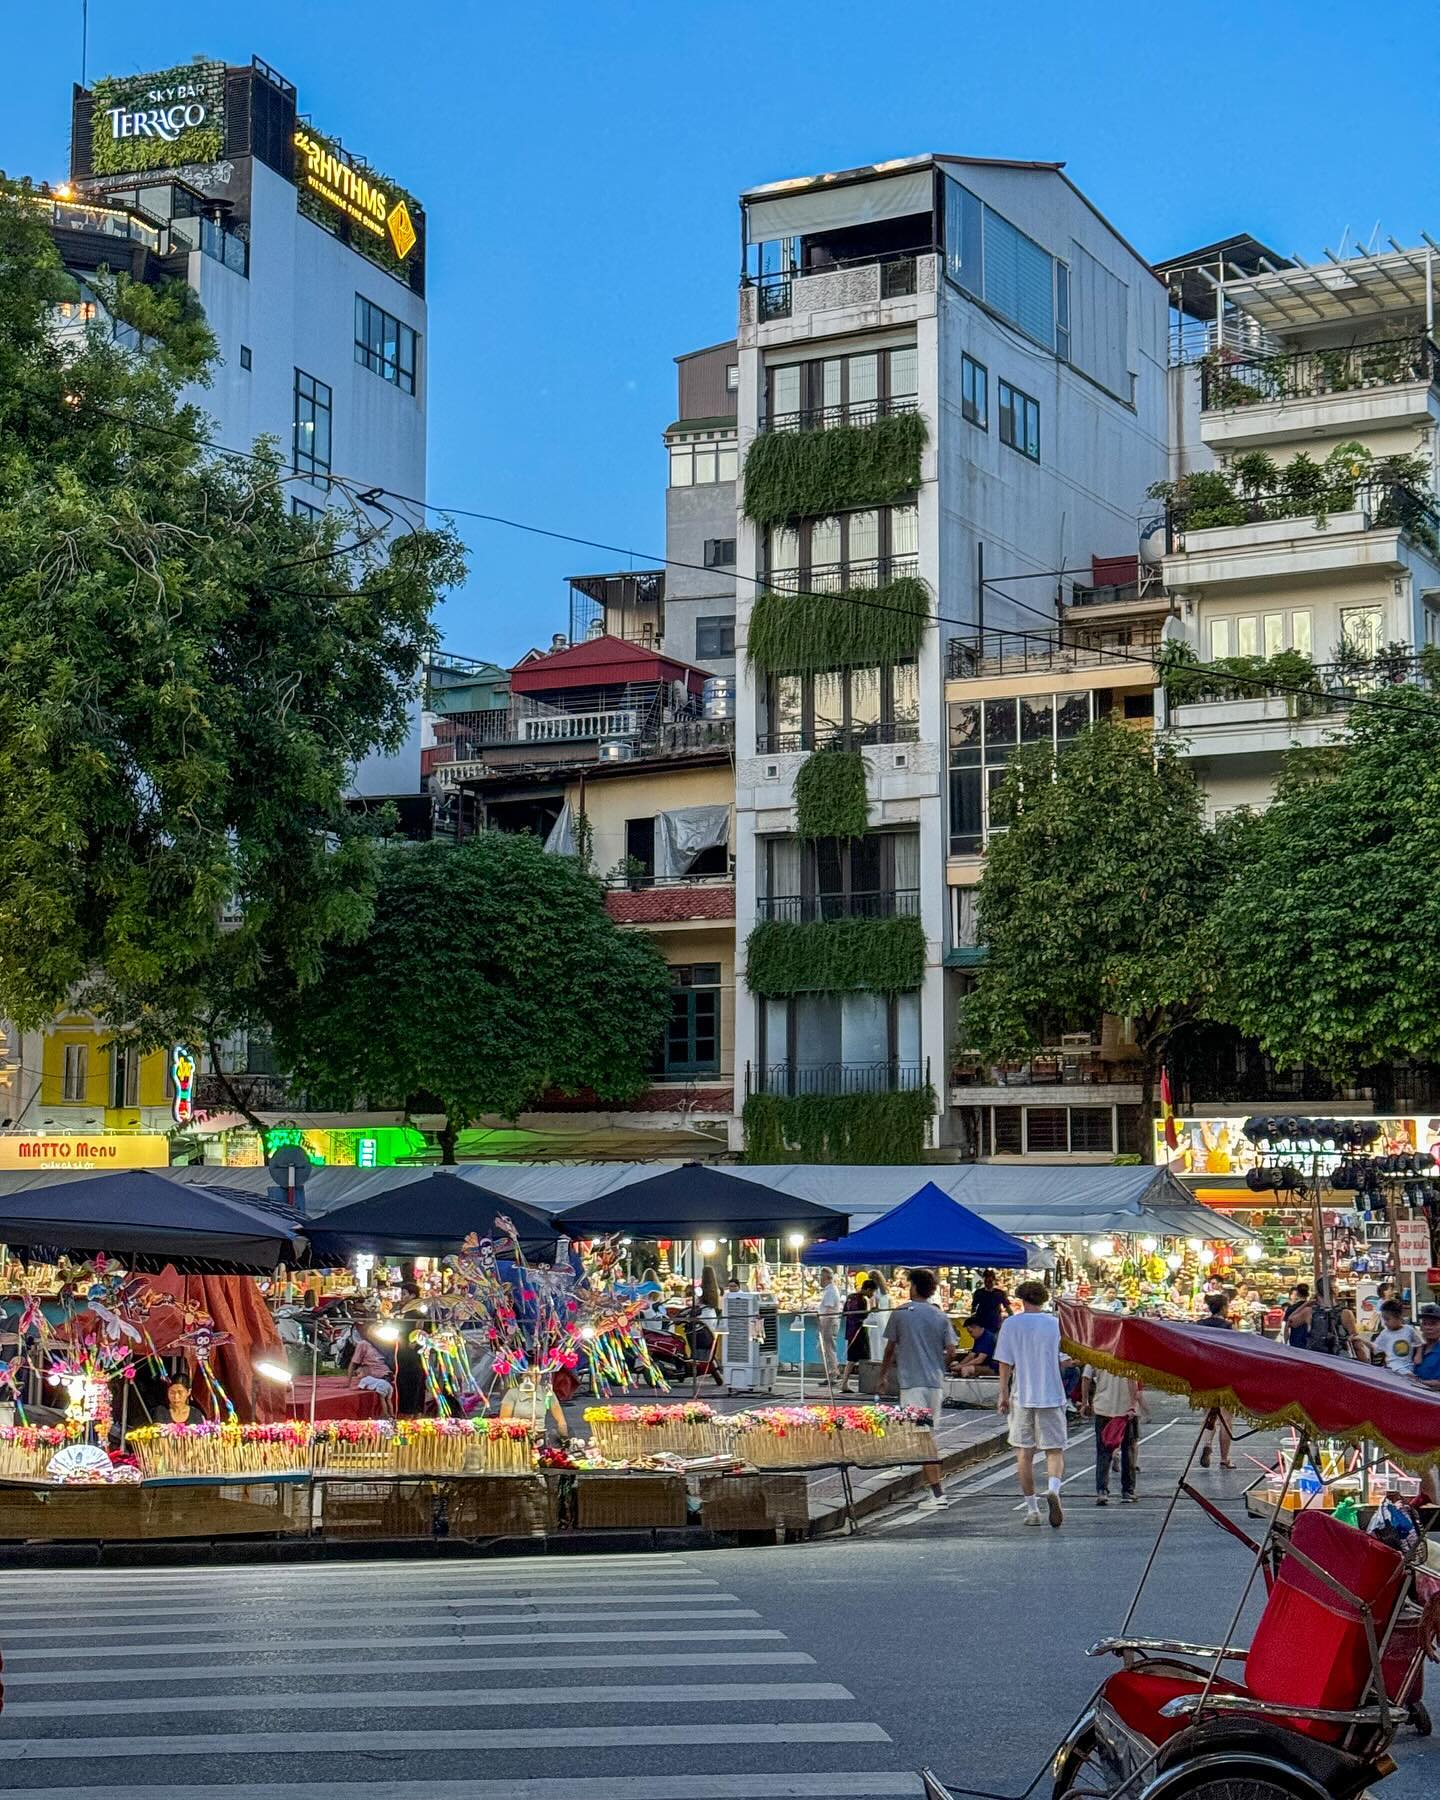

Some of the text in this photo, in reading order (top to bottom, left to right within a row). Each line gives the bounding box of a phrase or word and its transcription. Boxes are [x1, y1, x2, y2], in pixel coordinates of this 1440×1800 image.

[148, 83, 205, 104] SKY BAR
[308, 140, 386, 221] RHYTHMS
[18, 1142, 116, 1157] MATTO Menu
